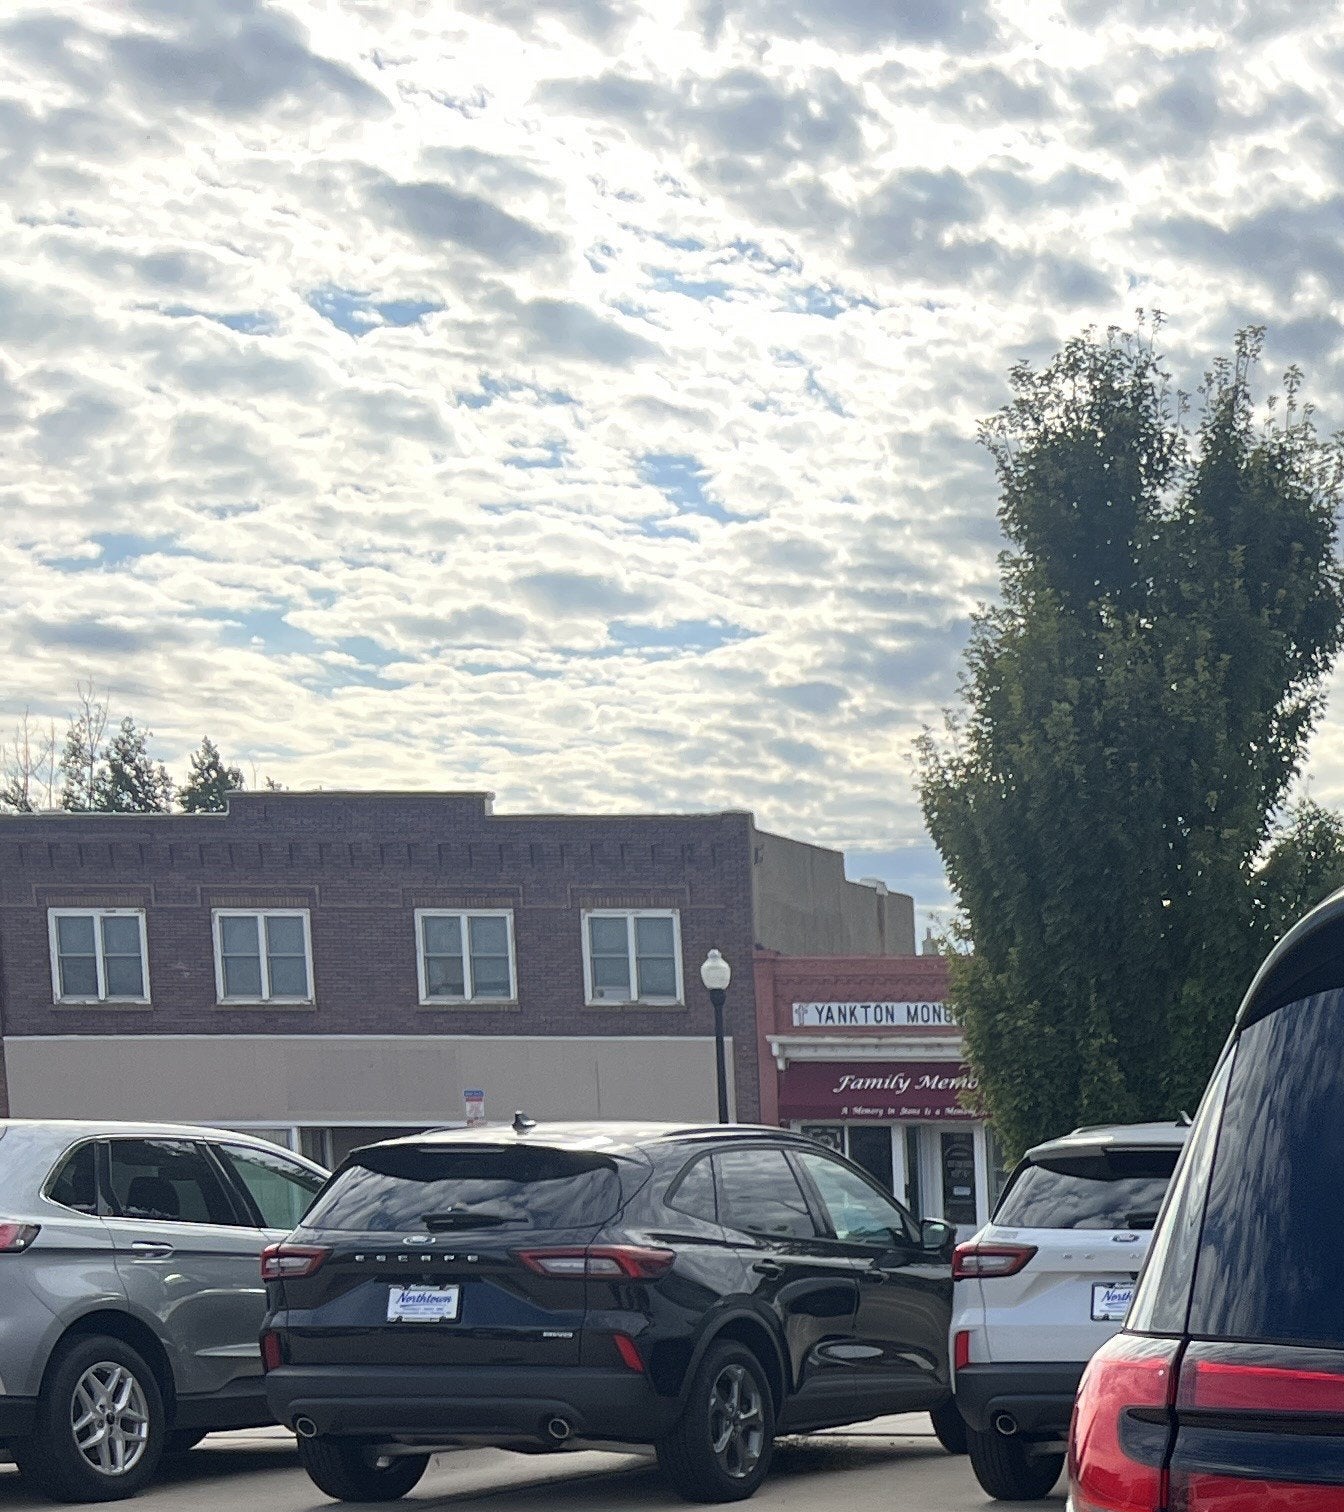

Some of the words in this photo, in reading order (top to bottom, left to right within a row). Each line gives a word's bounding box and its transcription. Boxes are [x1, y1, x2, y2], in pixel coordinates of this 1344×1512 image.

[814, 1004, 895, 1024] YANKTON
[833, 1072, 912, 1094] Family
[396, 1290, 452, 1304] Northtown
